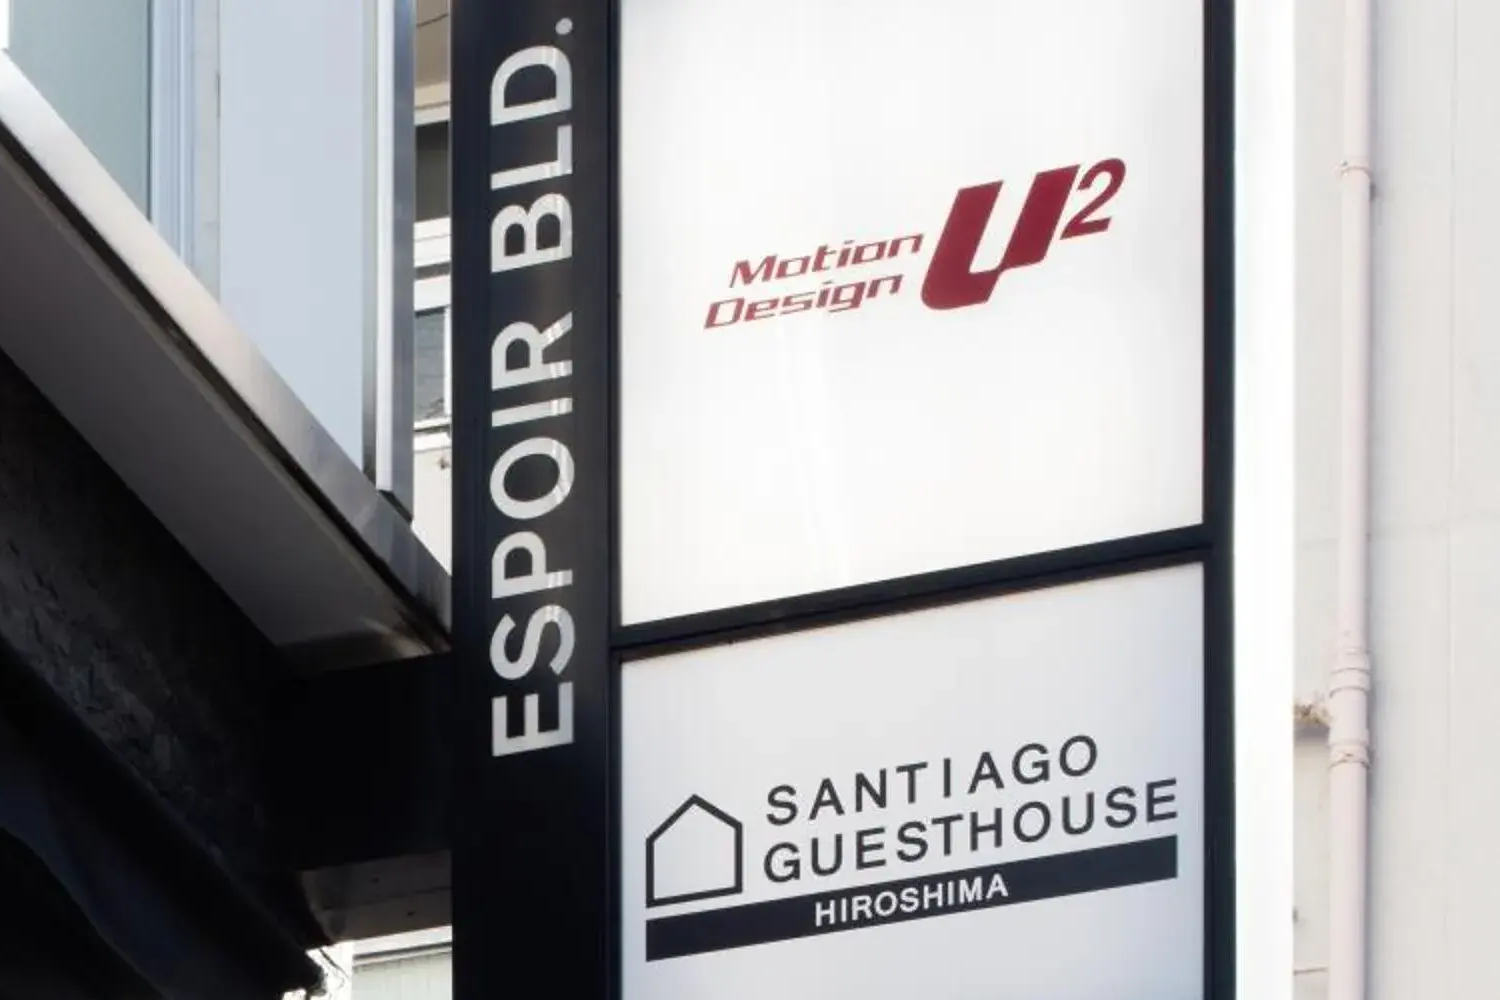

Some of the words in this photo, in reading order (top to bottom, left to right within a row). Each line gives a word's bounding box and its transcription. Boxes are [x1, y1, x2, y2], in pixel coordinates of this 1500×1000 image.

[490, 17, 574, 273] BLD.
[704, 274, 904, 330] Design
[729, 234, 924, 288] Motion
[490, 311, 575, 757] ESPOIR
[766, 735, 1098, 827] SANTIAGO
[763, 778, 1179, 883] GUESTHOUSE
[815, 873, 1010, 927] HIROSHIMA
